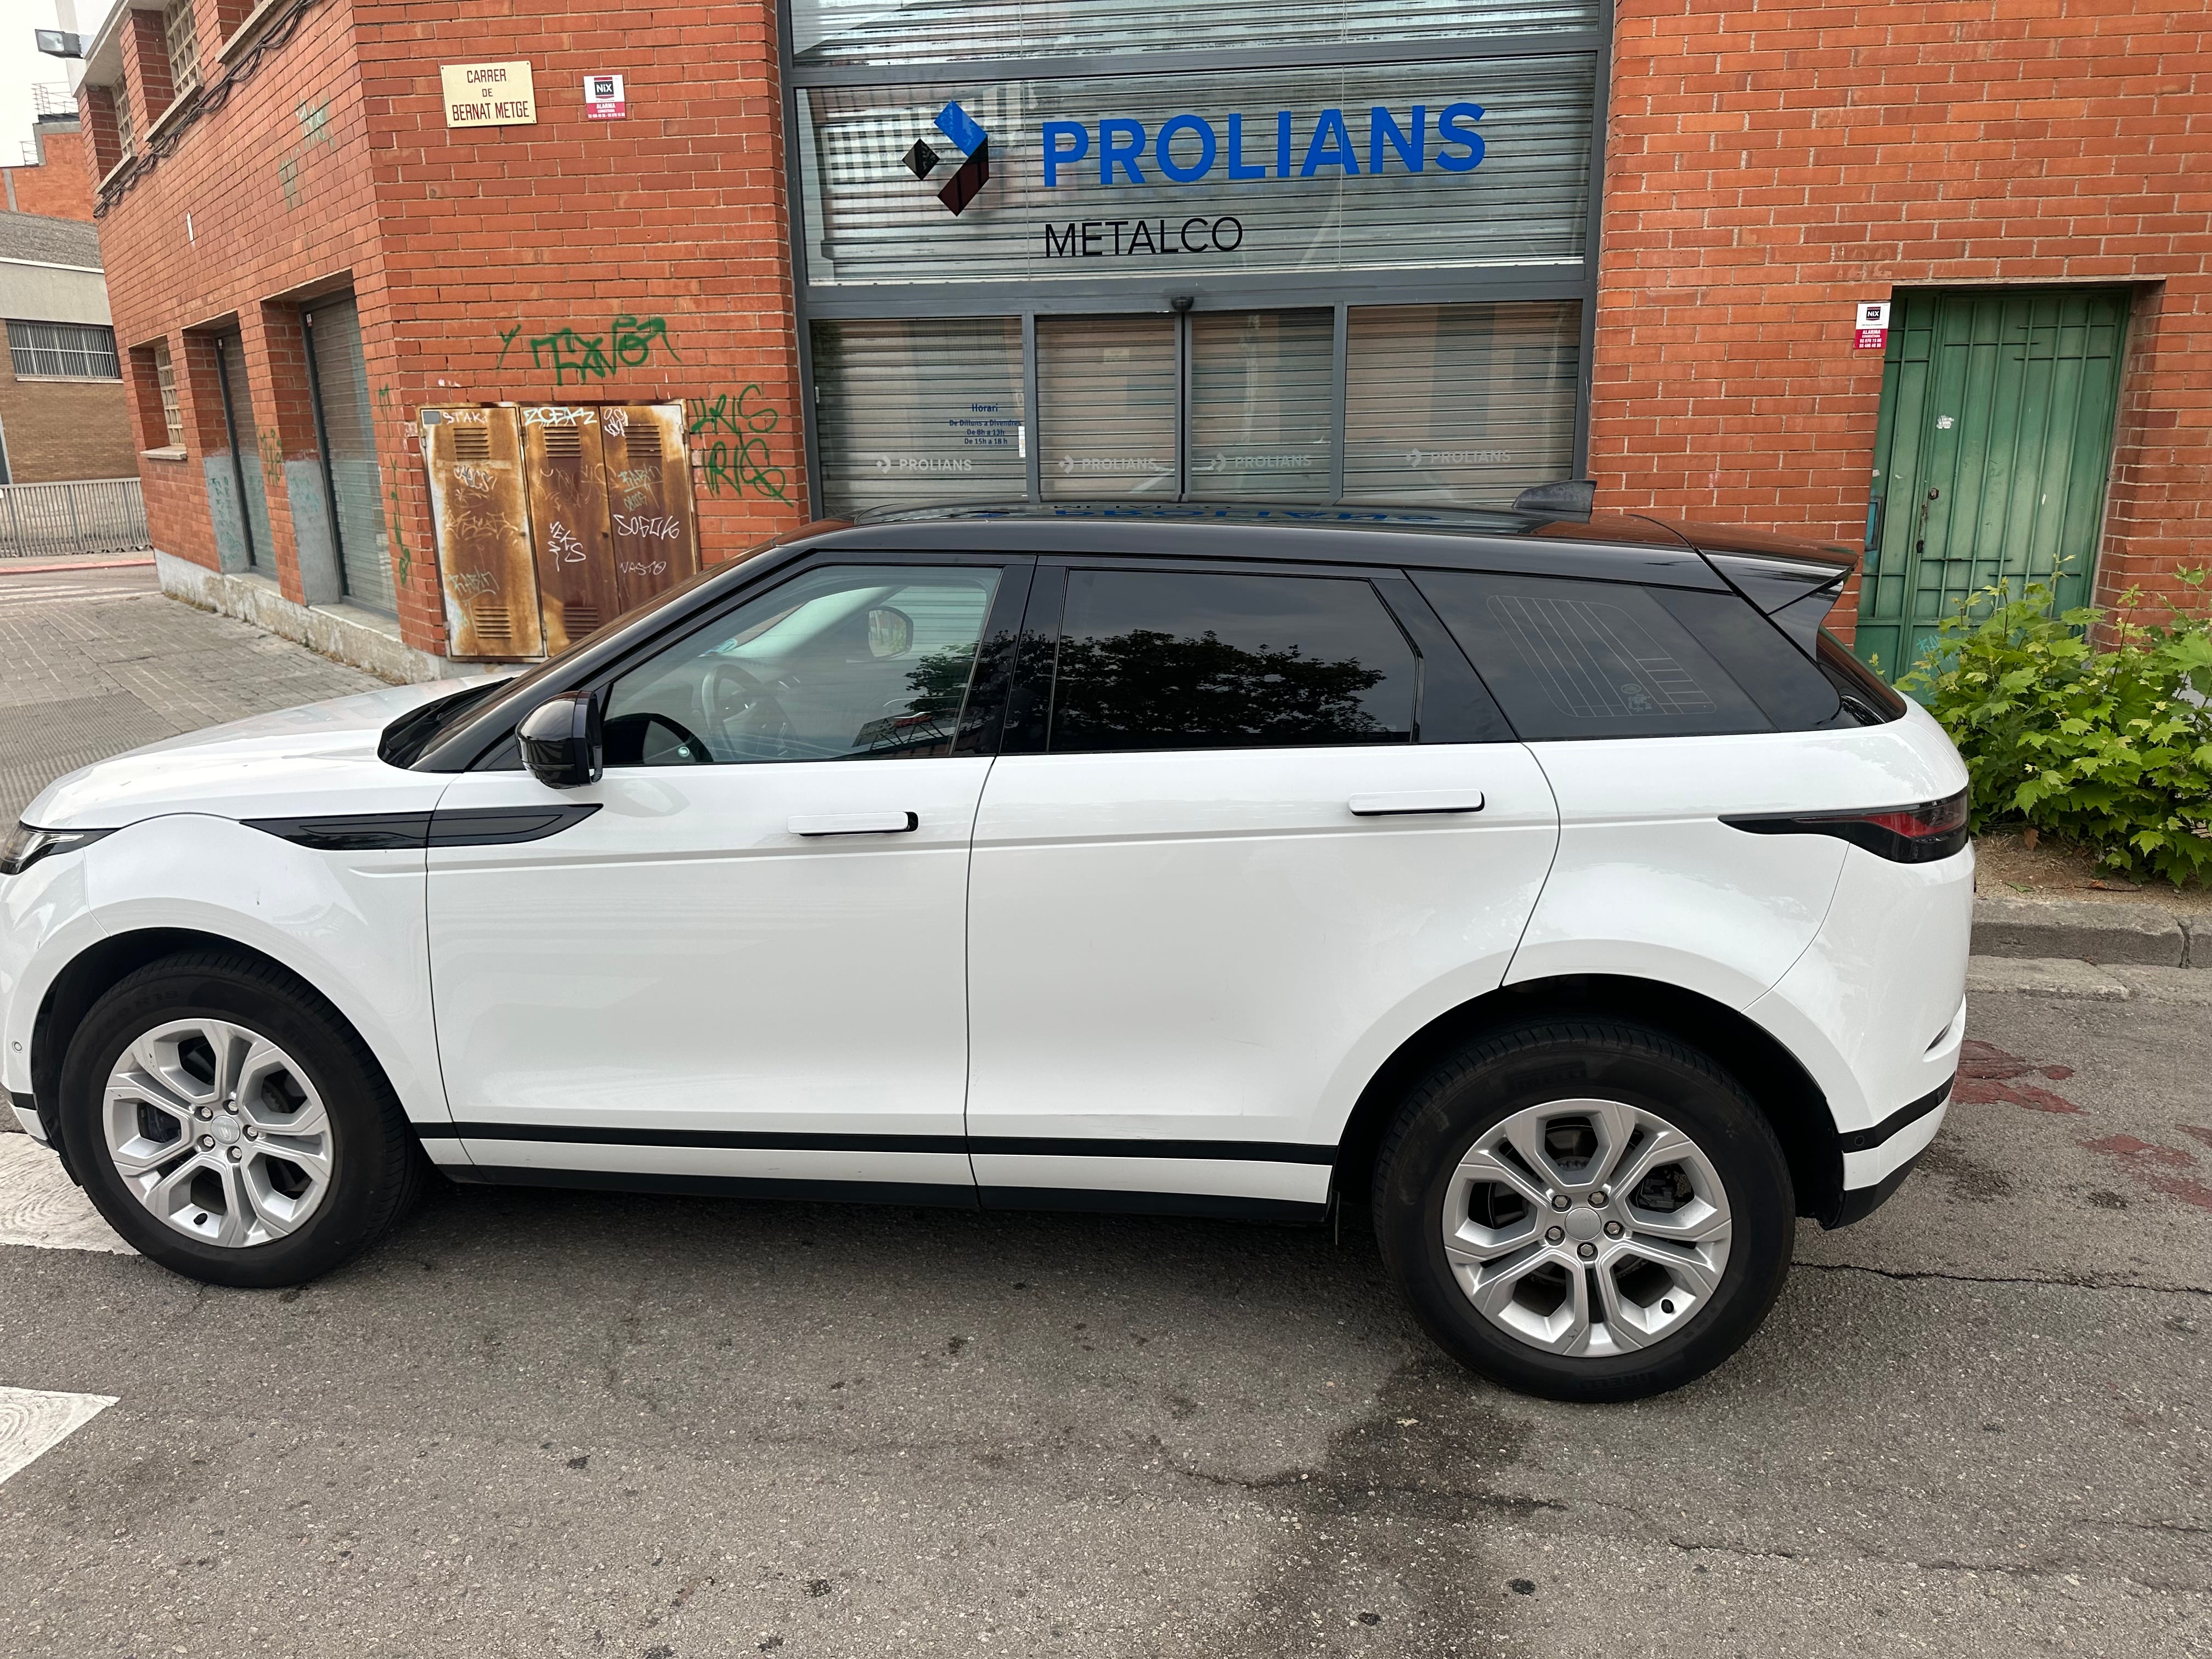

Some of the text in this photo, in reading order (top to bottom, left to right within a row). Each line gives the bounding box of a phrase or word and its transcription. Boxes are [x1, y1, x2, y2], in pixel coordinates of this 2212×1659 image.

[467, 69, 506, 83] CARRER
[482, 89, 493, 97] DE
[452, 101, 529, 121] BERNAT METGE
[1043, 103, 1485, 187] PROLIANS
[1045, 216, 1243, 257] METALCO
[972, 403, 998, 412] Horari
[1235, 455, 1312, 467] PROLIANS
[1430, 450, 1511, 464] PROLIANS
[899, 459, 972, 471] PROLIANS
[1082, 458, 1157, 470] PROLIANS
